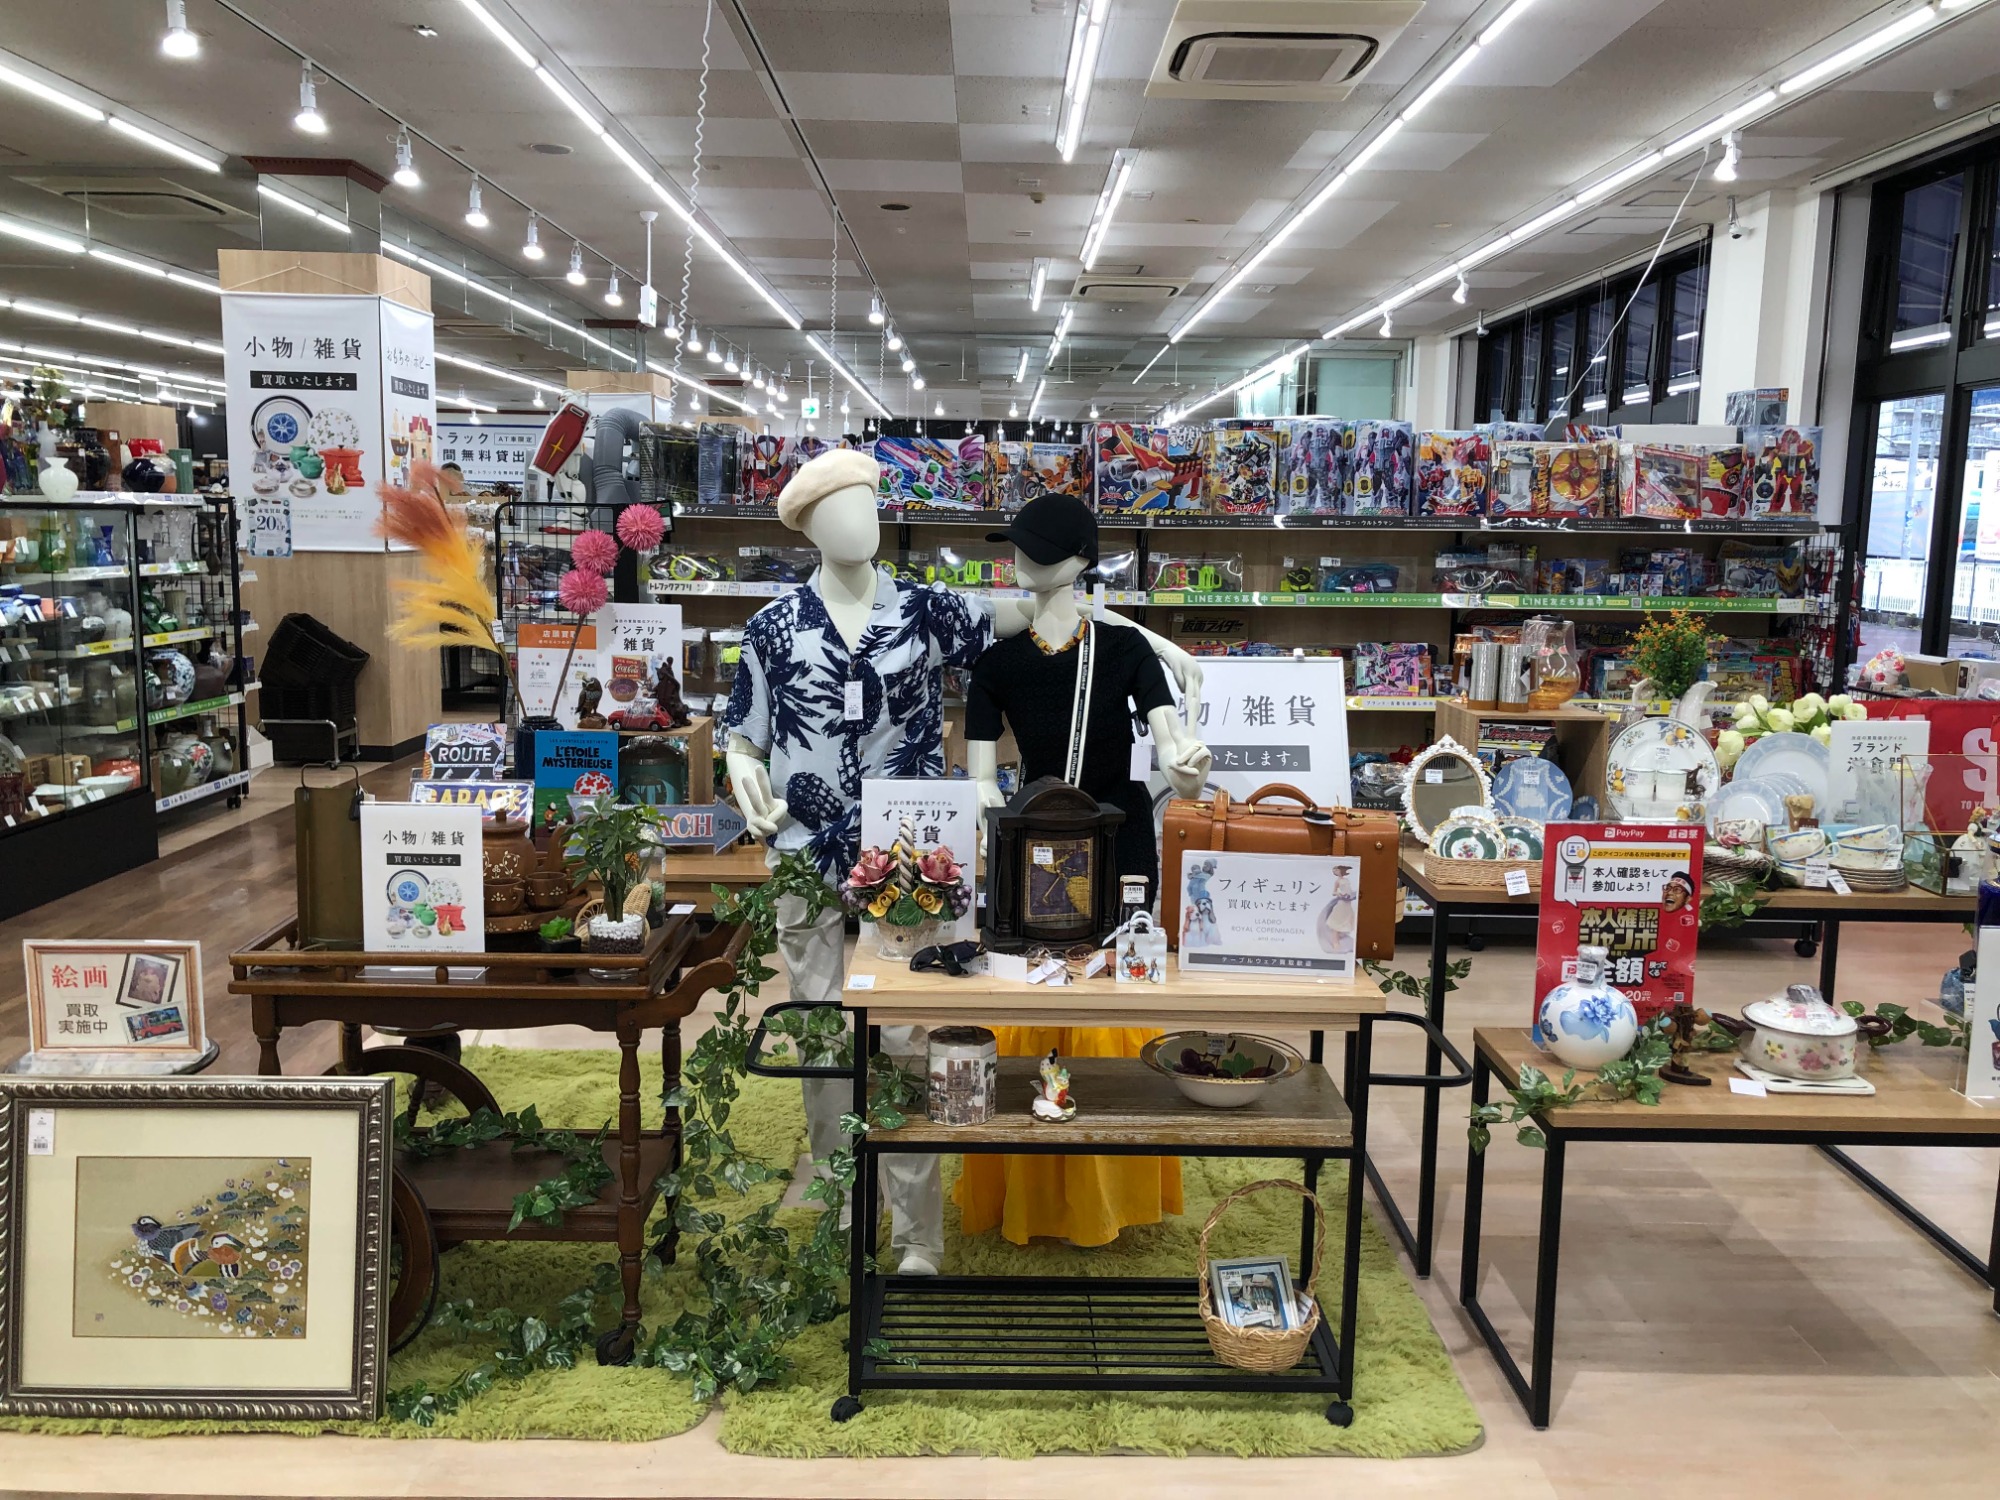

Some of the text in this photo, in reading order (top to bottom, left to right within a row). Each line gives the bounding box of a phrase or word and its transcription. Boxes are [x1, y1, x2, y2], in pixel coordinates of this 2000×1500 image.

[244, 336, 362, 360] 小物/雑貨
[261, 374, 350, 388] 買取いたします。
[257, 515, 277, 531] 20
[649, 583, 692, 591] トレファクアプリ
[1187, 594, 1268, 604] LINE友だち募中
[611, 626, 667, 636] インテリア
[623, 638, 655, 652] 雑貨
[438, 746, 492, 763] ROUTE
[1853, 742, 1903, 753] ブランド
[717, 819, 741, 831] 50m
[383, 830, 465, 846] 小物/雑貨
[1616, 829, 1646, 840] PayPay
[394, 855, 457, 864] 買取いたします。
[1593, 867, 1669, 878] 本人確認をして
[1219, 878, 1322, 895] フィギュリン
[1592, 881, 1650, 892] 参加しよう!
[1228, 899, 1312, 912] 買取いたします
[1580, 908, 1659, 928] 本人確認
[1255, 927, 1305, 936] COPENHAGEN
[1578, 928, 1658, 951] ジャンボ
[52, 964, 107, 988] 絵画
[66, 1003, 98, 1018] 買取
[58, 1019, 107, 1034] 実施中
